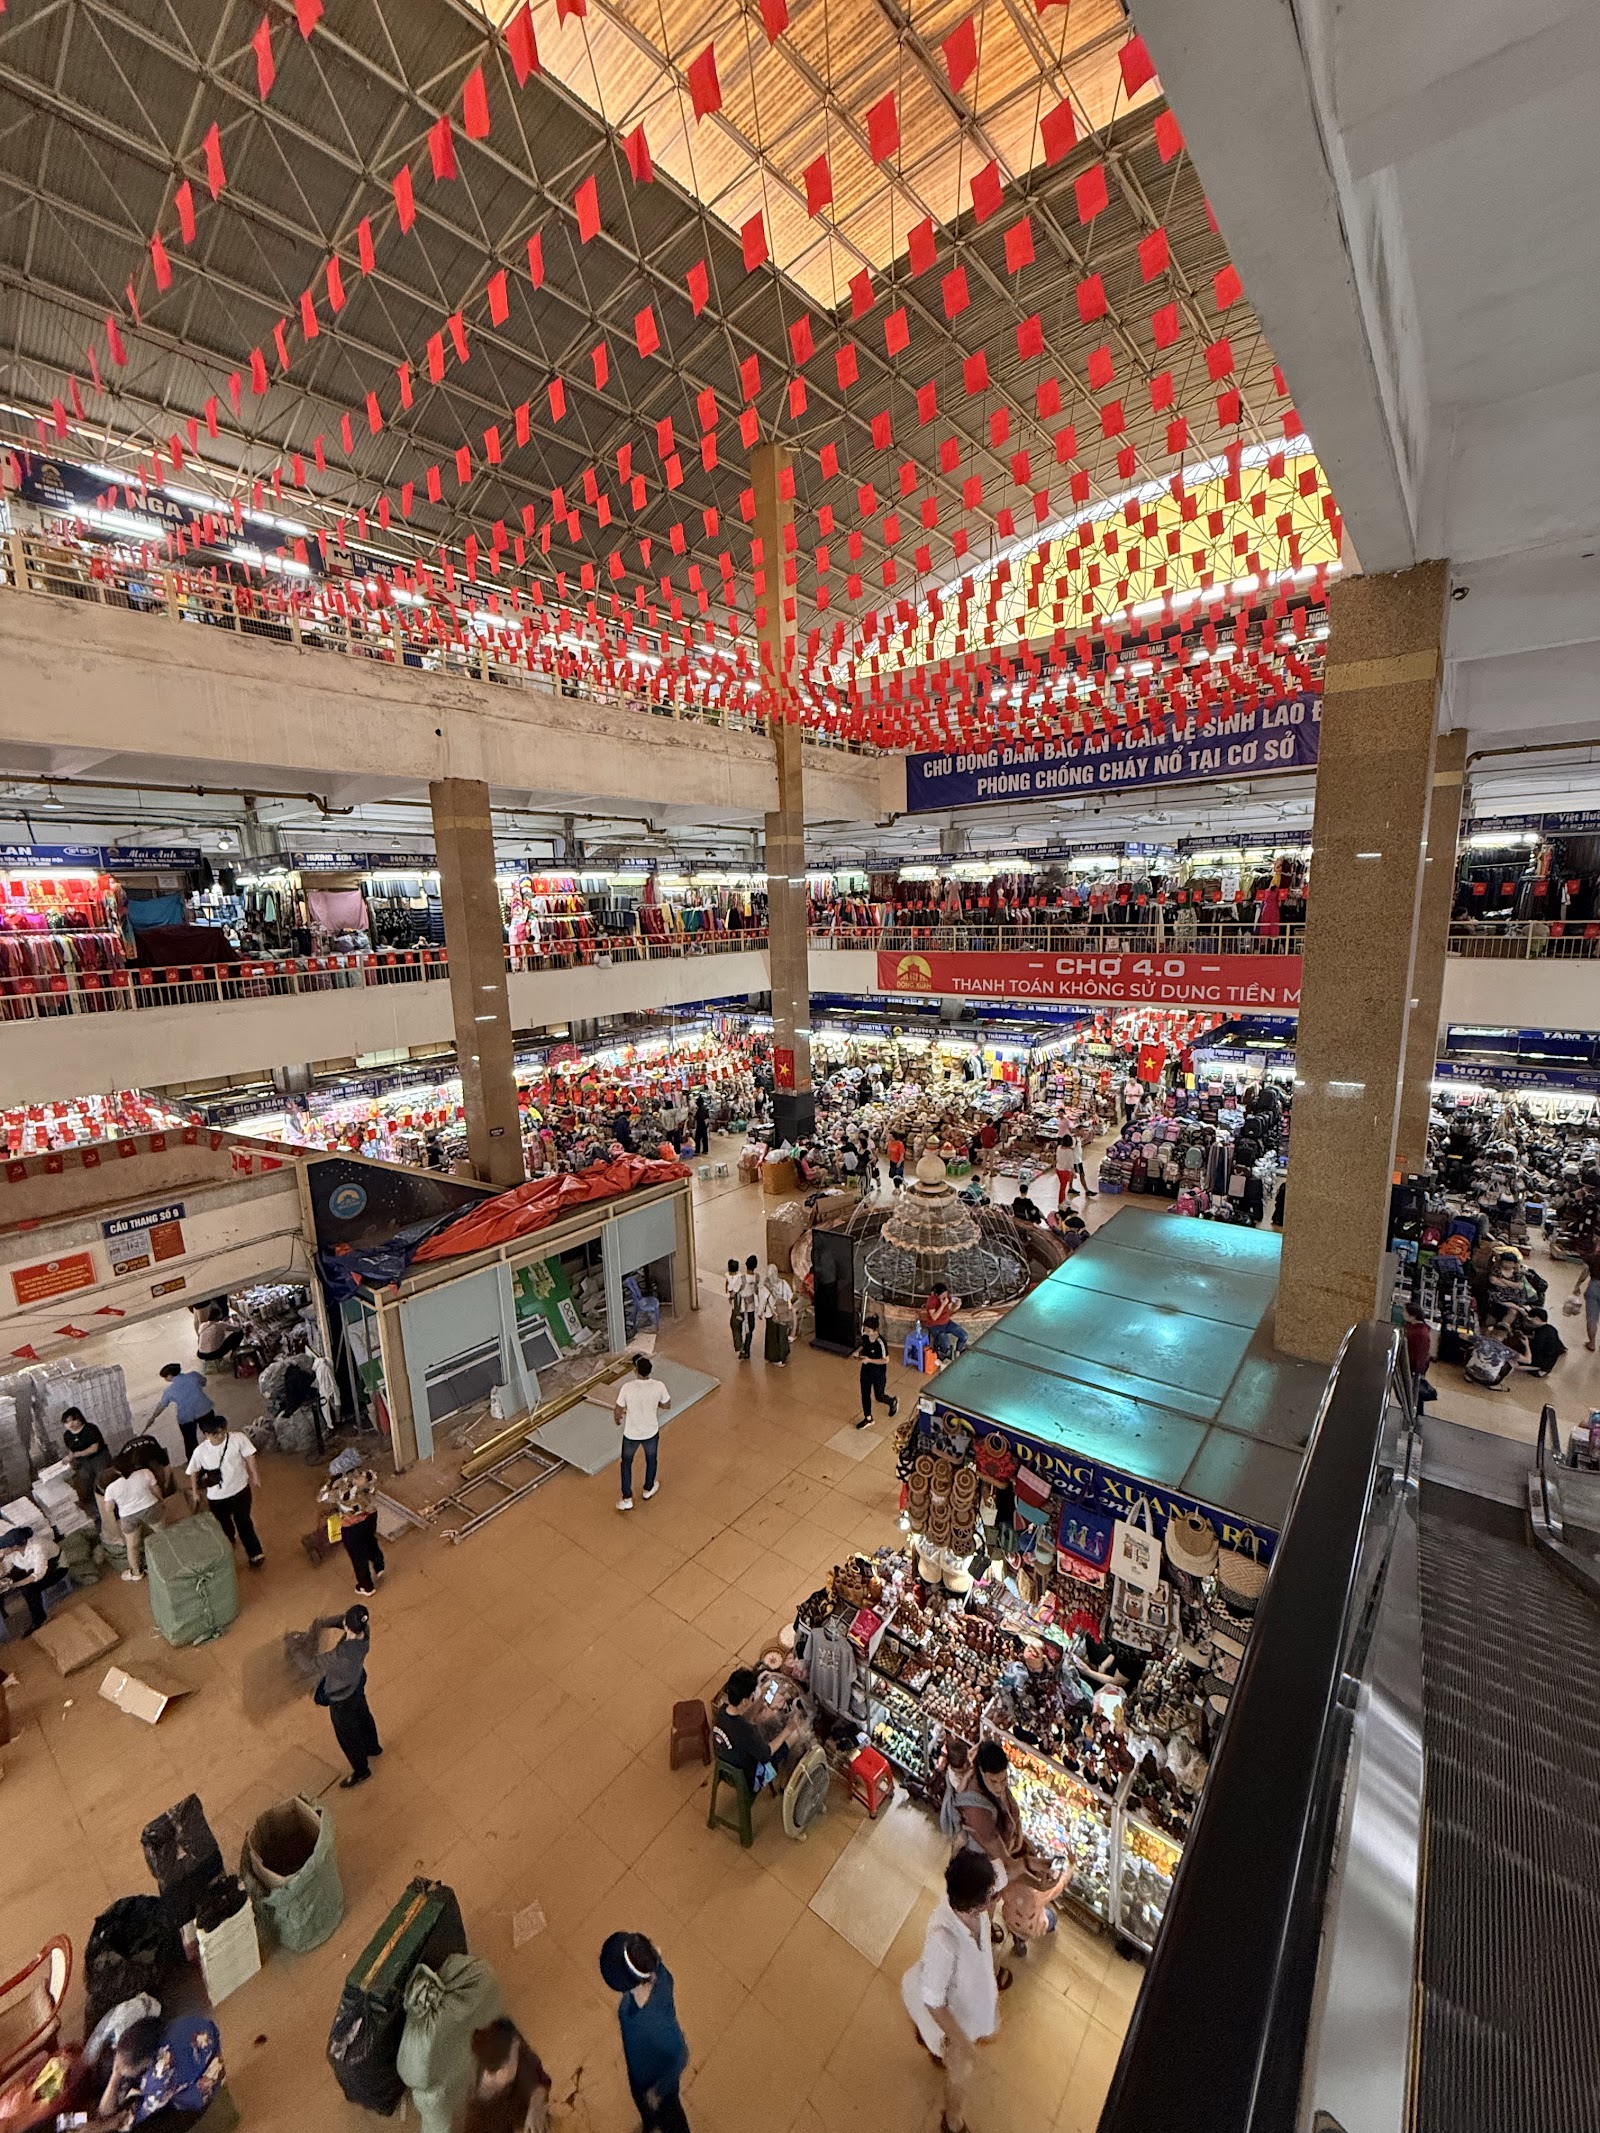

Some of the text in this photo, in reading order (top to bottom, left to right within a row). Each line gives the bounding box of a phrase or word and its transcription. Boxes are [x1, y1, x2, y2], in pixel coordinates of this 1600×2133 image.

[131, 492, 183, 519] NGA
[189, 508, 244, 537] TNH
[923, 754, 953, 779] CHỦ
[956, 749, 998, 775] ĐỘNG
[1262, 701, 1305, 730] LAO
[976, 730, 1296, 796] PHÒNG CHỐNG CHÁY NỔ TẠI CƠ SỞ
[1079, 842, 1116, 851] LAN ANH
[1056, 954, 1185, 979] CHỢ 4.0
[952, 977, 1005, 993] THANH
[1009, 974, 1055, 995] TOÁN
[1060, 978, 1125, 997] KHÔNG
[1129, 979, 1157, 998] SỬ
[1161, 984, 1221, 1002] DỤNG
[1227, 982, 1276, 1003] TIỀN
[1501, 1069, 1548, 1081] NGA
[129, 1213, 159, 1230] THANG
[160, 1208, 172, 1221] SỐ
[172, 1208, 180, 1218] 9
